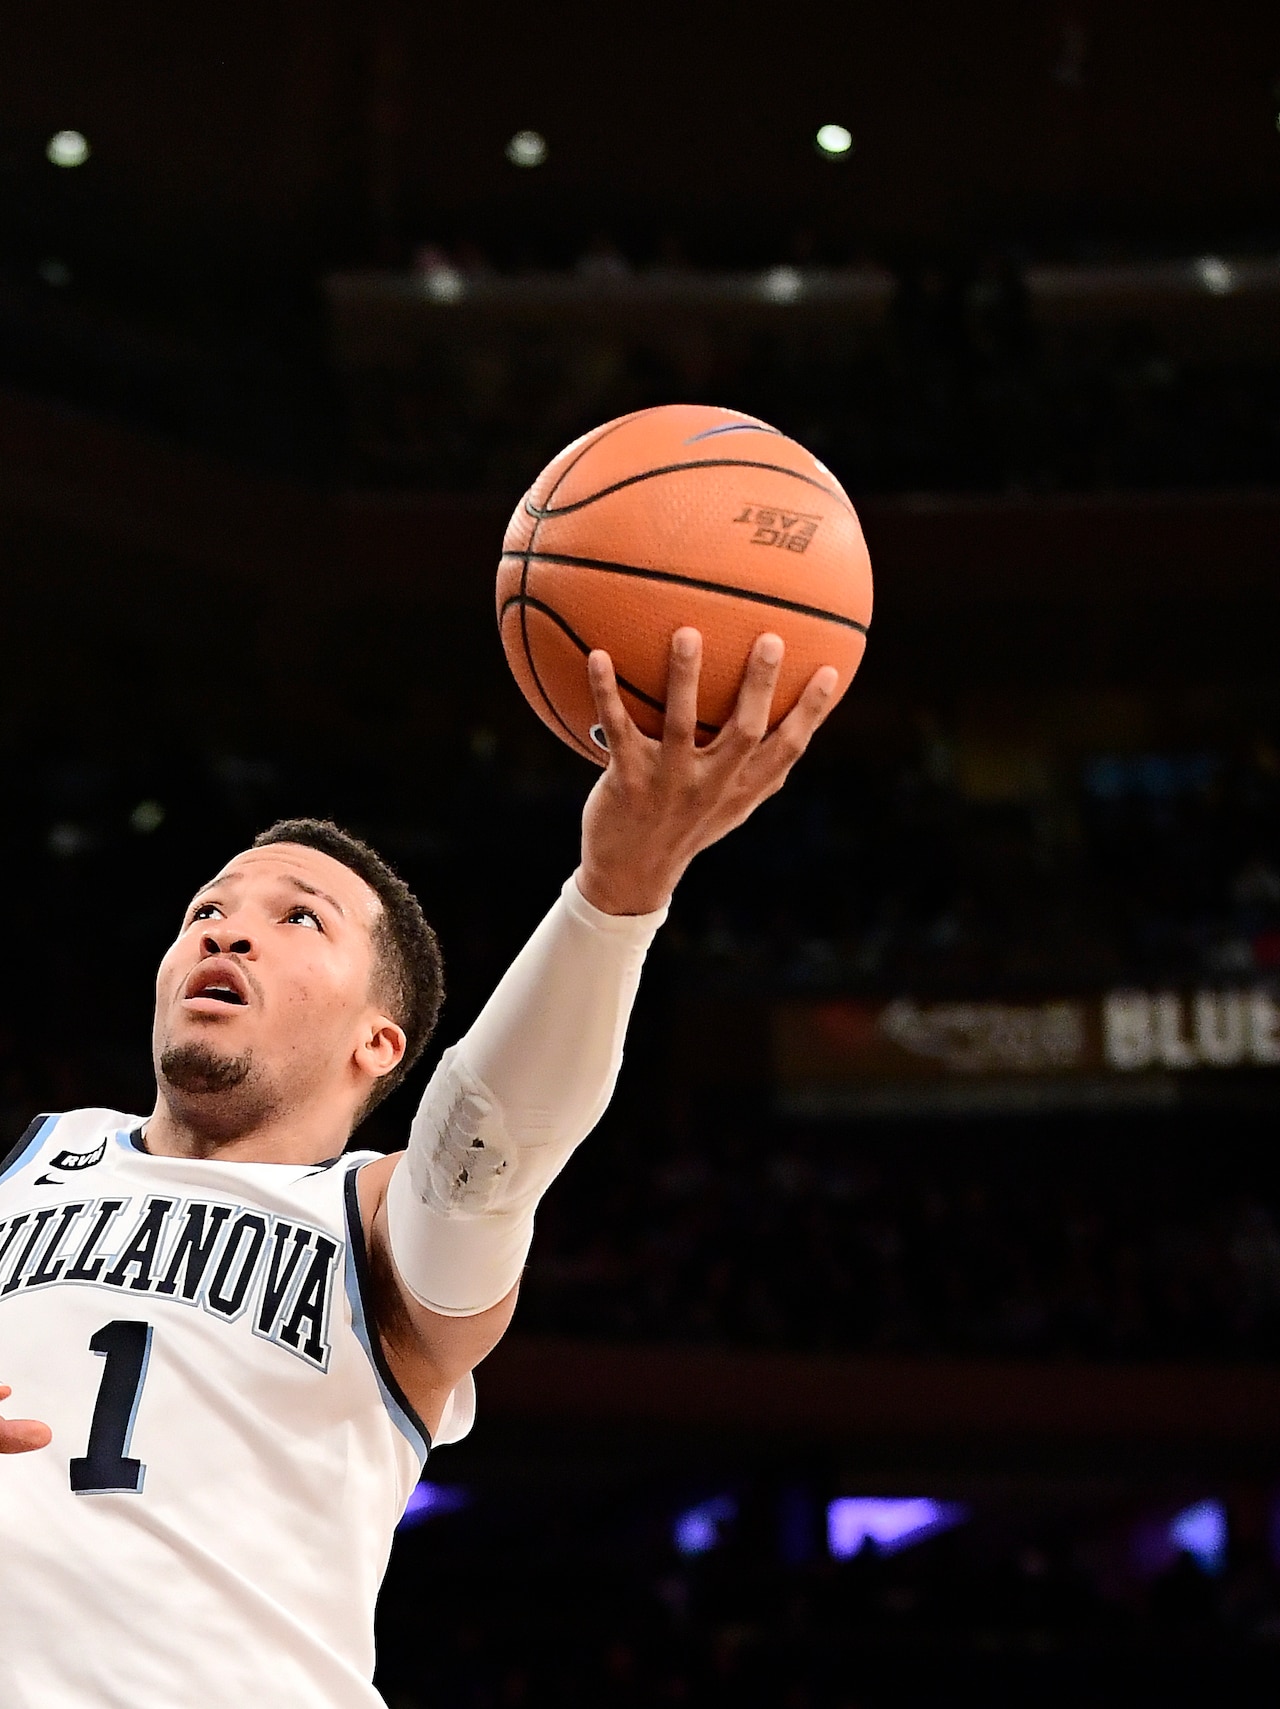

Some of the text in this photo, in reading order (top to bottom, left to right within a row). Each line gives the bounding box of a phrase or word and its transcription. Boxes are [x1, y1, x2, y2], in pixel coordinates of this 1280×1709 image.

[733, 507, 818, 537] EAST
[750, 527, 810, 553] BIG
[70, 1321, 153, 1494] 1
